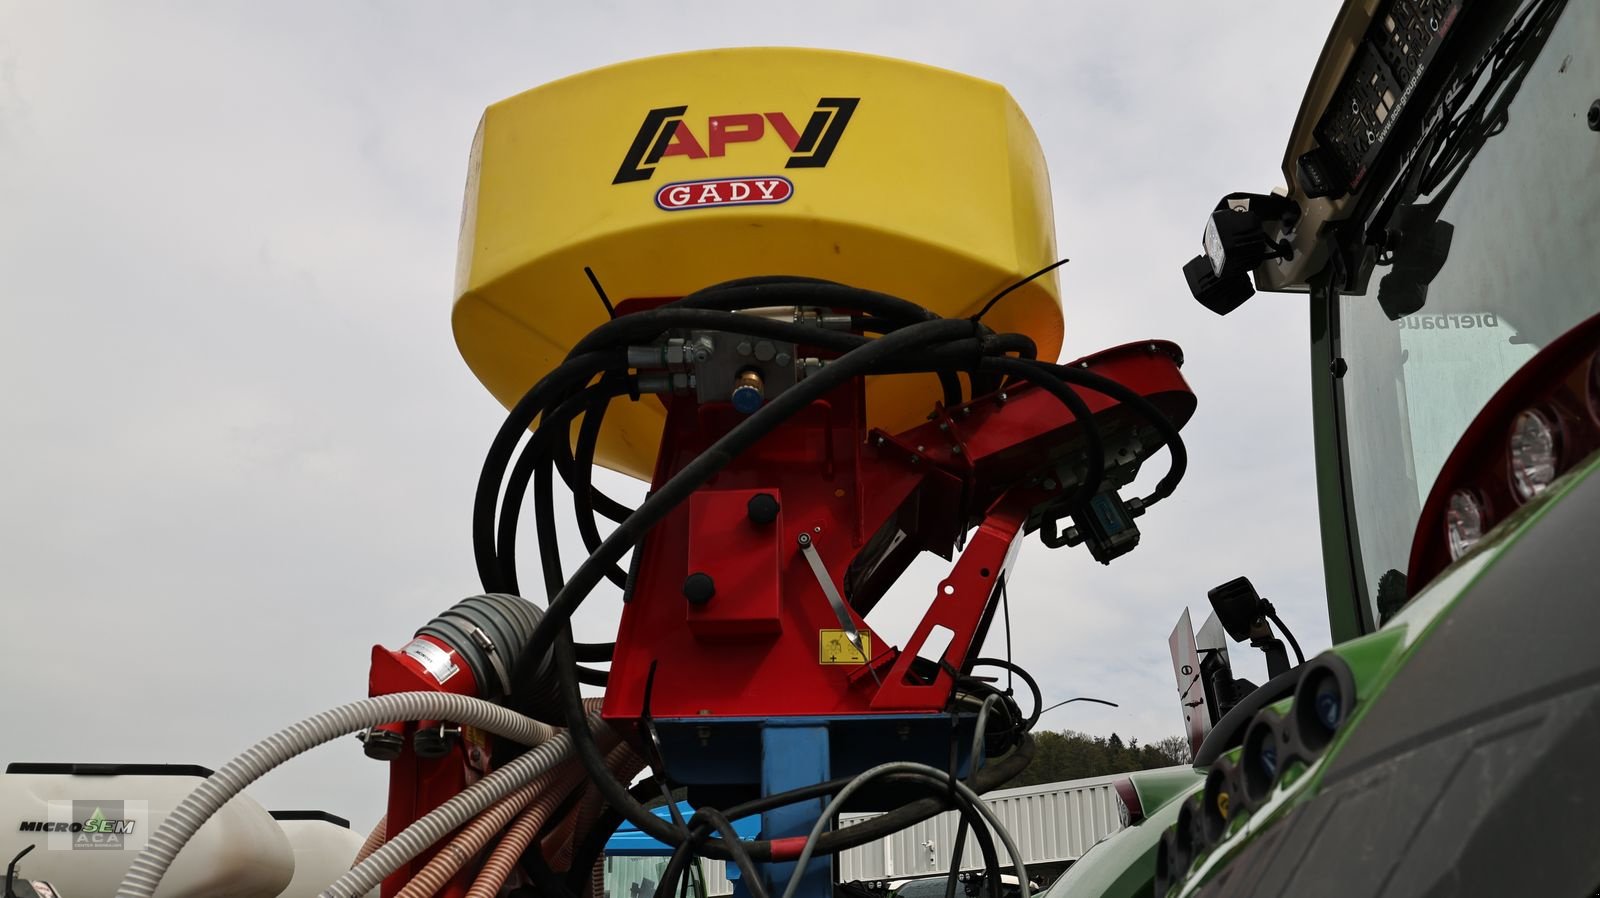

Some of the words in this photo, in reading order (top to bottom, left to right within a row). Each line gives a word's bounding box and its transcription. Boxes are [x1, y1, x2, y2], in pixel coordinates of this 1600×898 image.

[1376, 63, 1425, 144] www.aca-group.at
[669, 181, 779, 206] GADY
[19, 819, 136, 835] MICROSEM
